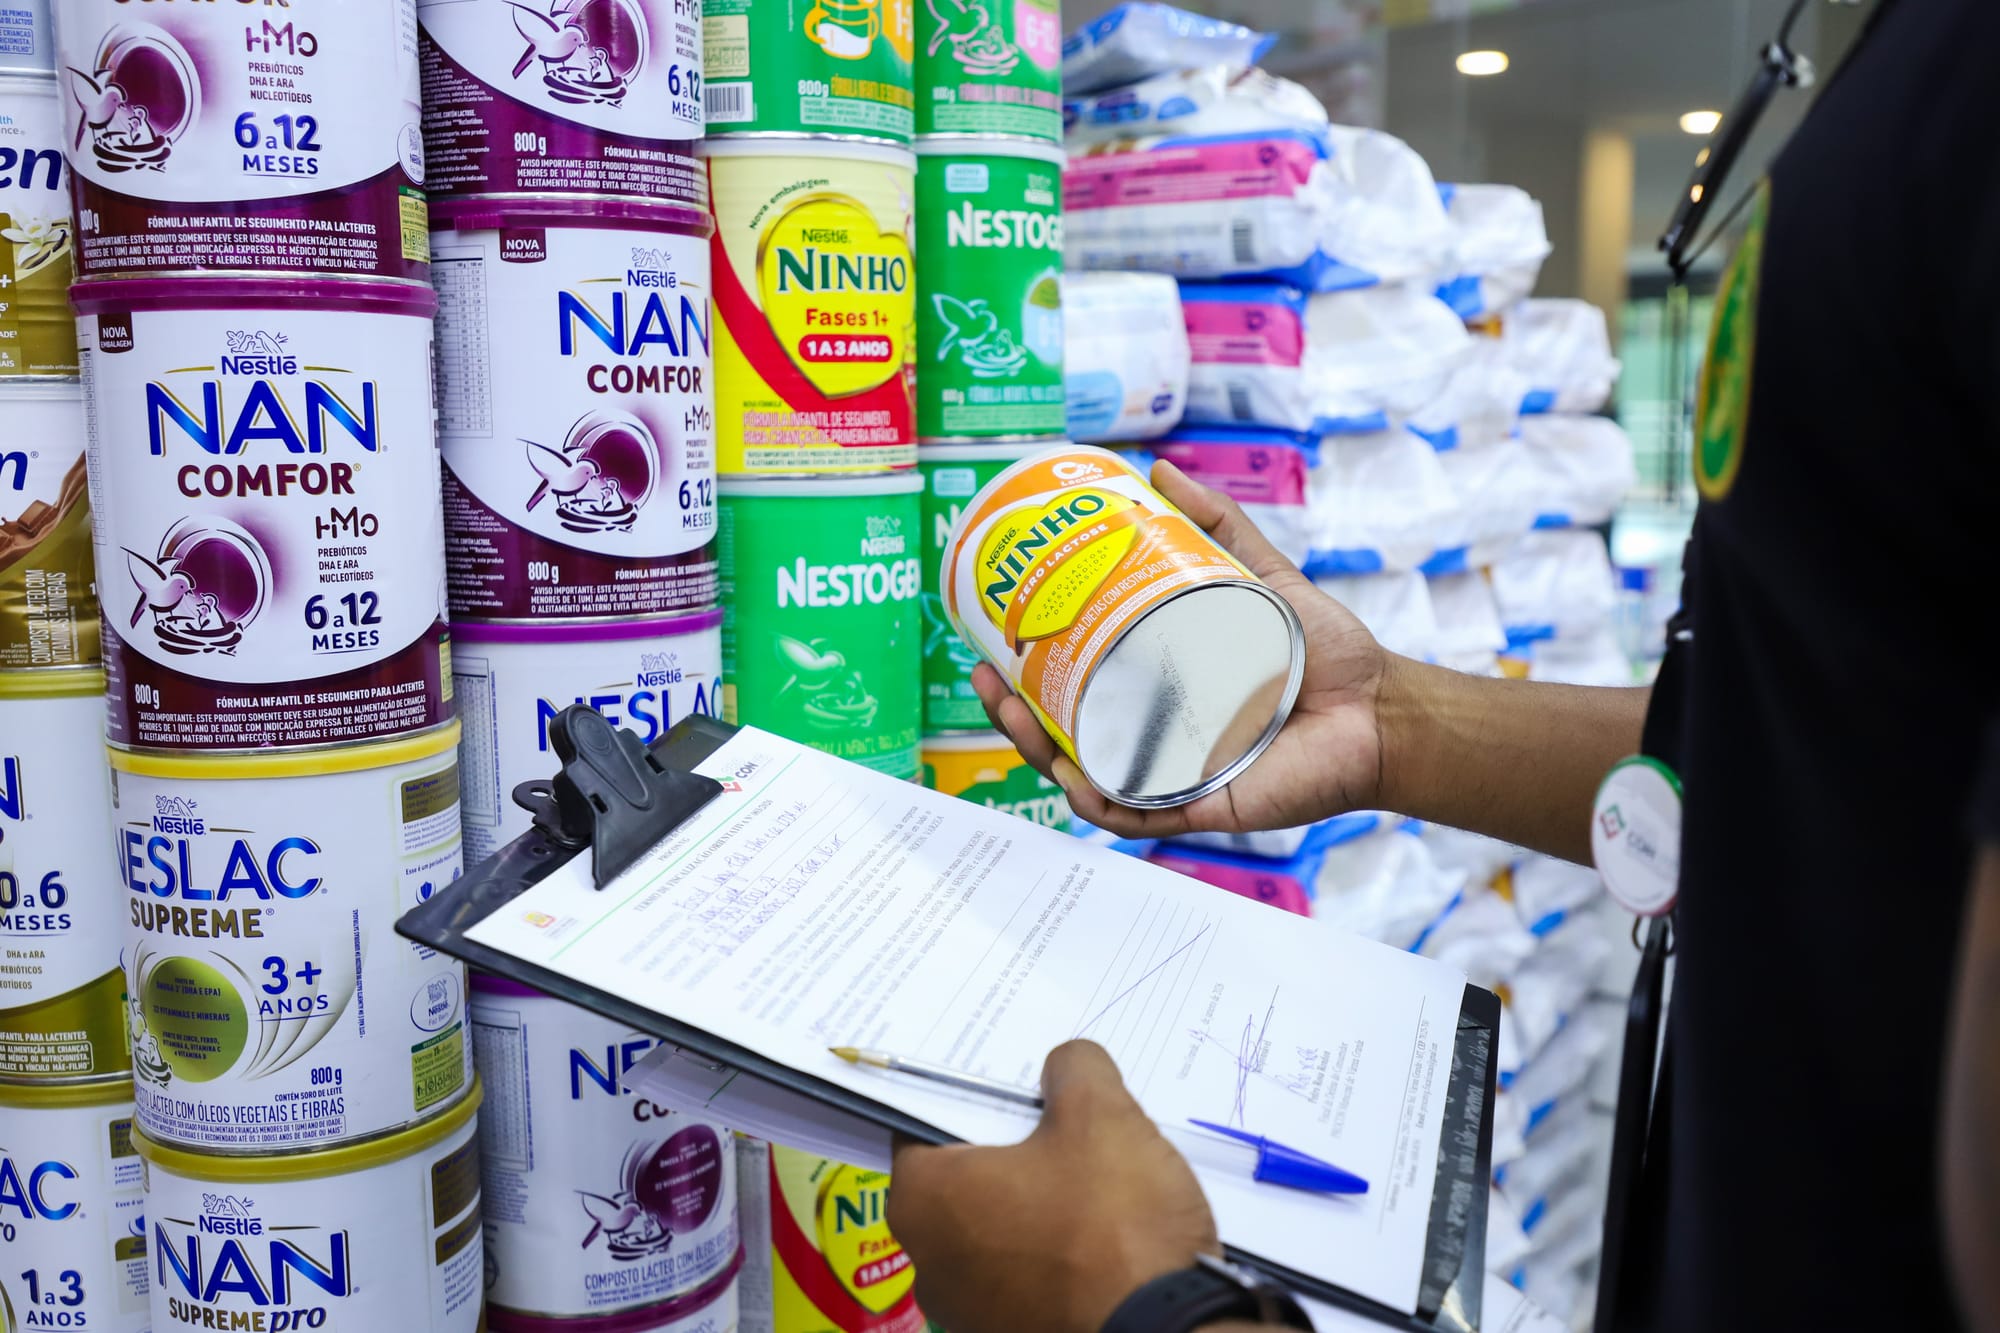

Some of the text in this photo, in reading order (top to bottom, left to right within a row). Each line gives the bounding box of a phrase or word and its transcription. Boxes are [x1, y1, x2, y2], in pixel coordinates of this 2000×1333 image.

[245, 19, 318, 57] HMO
[248, 61, 304, 76] PREBIÓTICOS
[249, 76, 294, 89] DHA ARA
[250, 89, 313, 104] NUCLEOTÍDEOS
[275, 114, 322, 152] 12
[514, 132, 547, 156] 800 g
[604, 145, 667, 162] FÓRMULA INFANTIL
[243, 154, 319, 174] MESES
[749, 177, 830, 230] Nova embalagem
[148, 215, 376, 235] FÓRMULA INFANTIL DE SEGUIMENTO PARA LACTENTES
[506, 239, 540, 250] NOVA
[802, 229, 851, 244] Nestlé
[502, 251, 545, 260] EMBALAGEM
[628, 270, 676, 288] Nestlé
[777, 248, 906, 293] NINHO
[558, 291, 711, 358] NAN
[806, 309, 867, 326] Fases
[102, 326, 128, 338] NOVA
[100, 338, 133, 349] EMBALAGEM
[807, 341, 889, 356] 1 A 3 ANOS
[221, 355, 297, 376] Nestlé
[587, 364, 703, 394] COMFOR
[146, 380, 381, 457] NAN
[177, 462, 356, 498] COMFOR
[1052, 461, 1104, 480] 0%
[1060, 473, 1104, 488] Lactose
[315, 506, 379, 540] HMO
[682, 513, 712, 528] MESES
[318, 545, 368, 558] PREBIÓTICOS
[985, 527, 1018, 569] Nestlé
[985, 494, 1105, 613] NINHO
[319, 559, 360, 571] DHA E ARA
[528, 562, 559, 584] 800 g
[615, 566, 676, 581] FÓRMULA INFANTIL
[1018, 524, 1109, 605] ZERO LACTOSE
[319, 571, 374, 584] NUCLEOTÍDEOS
[1043, 545, 1109, 609] ZERO LACTOSE
[1044, 553, 1107, 619] MAIS VENDIDO
[341, 591, 382, 627] 12
[1068, 563, 1162, 647] PARA DIETAS COM RESTRIÇÃO
[25, 570, 51, 663] COMPOSTO LÁCTEO COM
[46, 572, 72, 664] VITAMINAS MINERAIS
[312, 630, 380, 651] MESES
[637, 669, 682, 687] Nestlé
[135, 683, 160, 709] 800 g
[216, 680, 425, 709] FÓRMULA INFANTIL DE SEGUIMENTO PARA LACTENTES
[155, 694, 426, 723] IMPORTANTE: ESTE PRODUTO SOMENTE DEVE SER USADO NA ALIMENTAÇÃO DE CRIANÇAS
[153, 816, 206, 836] Nestlé
[39, 870, 67, 909] 6
[130, 897, 265, 938] SUPREME
[7, 950, 45, 959] DHA ARA
[261, 955, 322, 995] 3+
[258, 994, 330, 1016] ANOS
[25, 1031, 87, 1042] PARA LACTENTES
[311, 1067, 342, 1086] 800 g
[274, 1087, 343, 1103] CONTÉM SORO DE LEITE
[150, 1090, 345, 1124] LÁCTEO COM ÓLEOS VEGETAIS E FIBRAS
[199, 1215, 264, 1236] Nestlé
[155, 1221, 352, 1305] NAN
[585, 1267, 639, 1290] COMPOSTO
[642, 1258, 675, 1281] LÁCTEO
[676, 1251, 695, 1272] COM
[26, 1310, 87, 1326] ANOS
[168, 1297, 327, 1333] SUPREME pro
